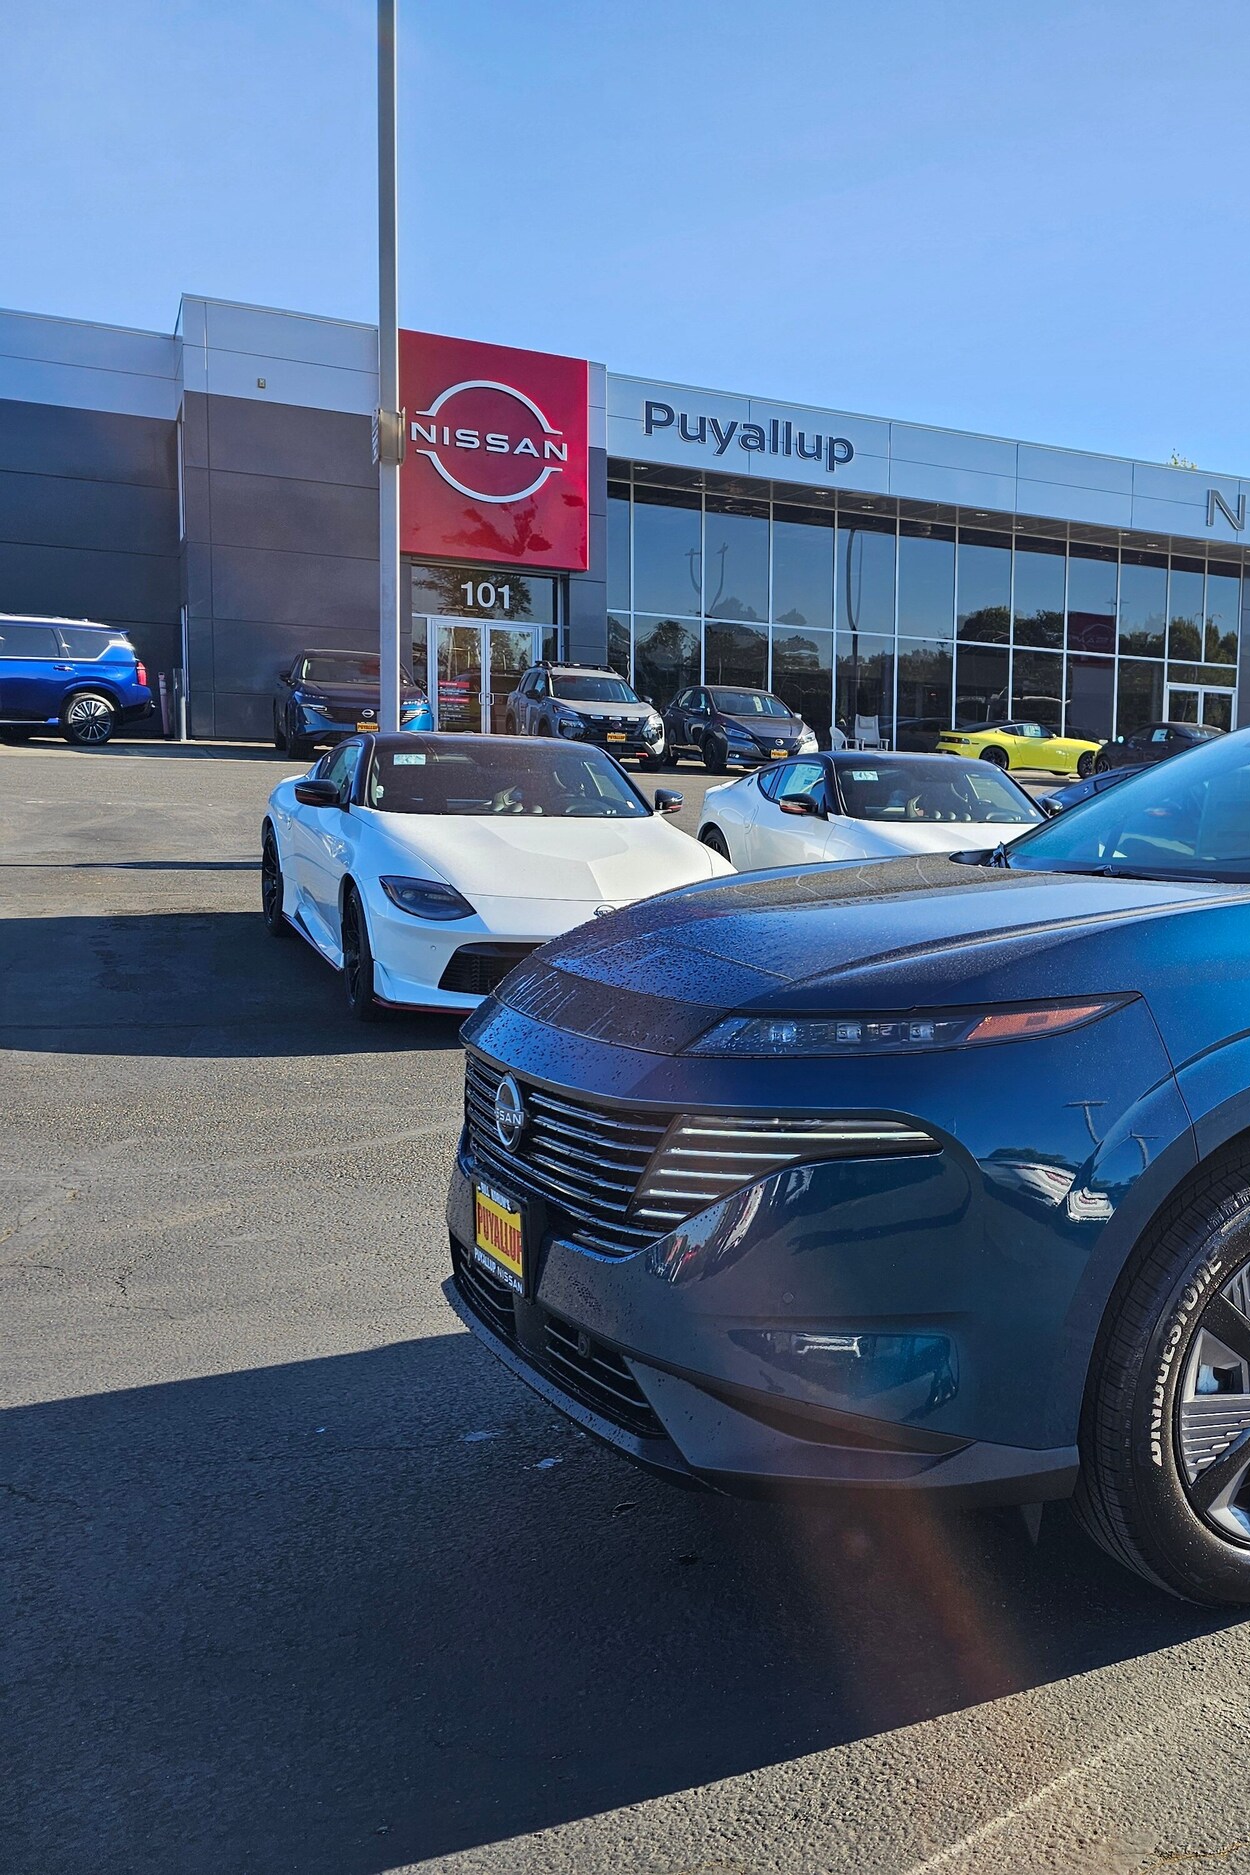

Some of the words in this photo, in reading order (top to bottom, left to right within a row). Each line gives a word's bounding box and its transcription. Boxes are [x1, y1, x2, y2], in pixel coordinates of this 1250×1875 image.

[410, 421, 568, 462] NISSAN
[644, 400, 854, 472] Puyallup
[461, 581, 510, 610] 101
[476, 1202, 522, 1265] PUYALLUP
[496, 1264, 523, 1295] NISSAN
